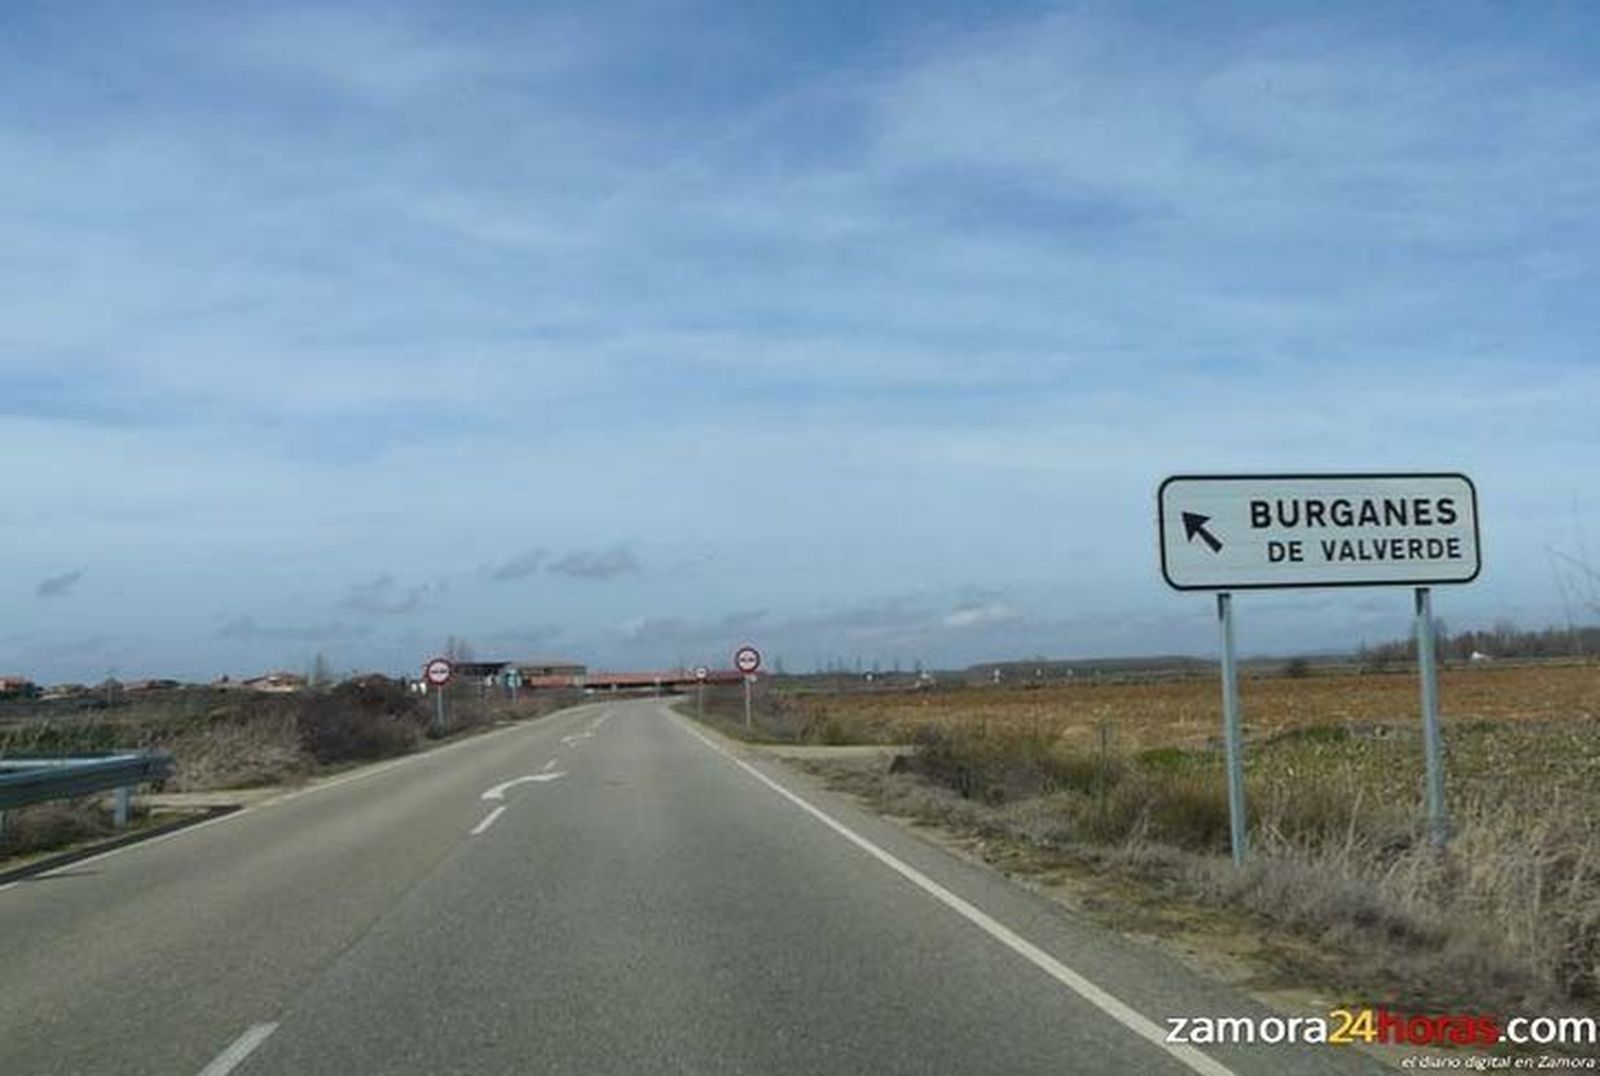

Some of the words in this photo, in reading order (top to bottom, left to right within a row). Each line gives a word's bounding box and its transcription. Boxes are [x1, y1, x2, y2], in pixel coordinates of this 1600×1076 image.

[1250, 498, 1458, 529] BURGANES
[1268, 541, 1304, 562] DE
[1321, 538, 1462, 561] VALVERDE
